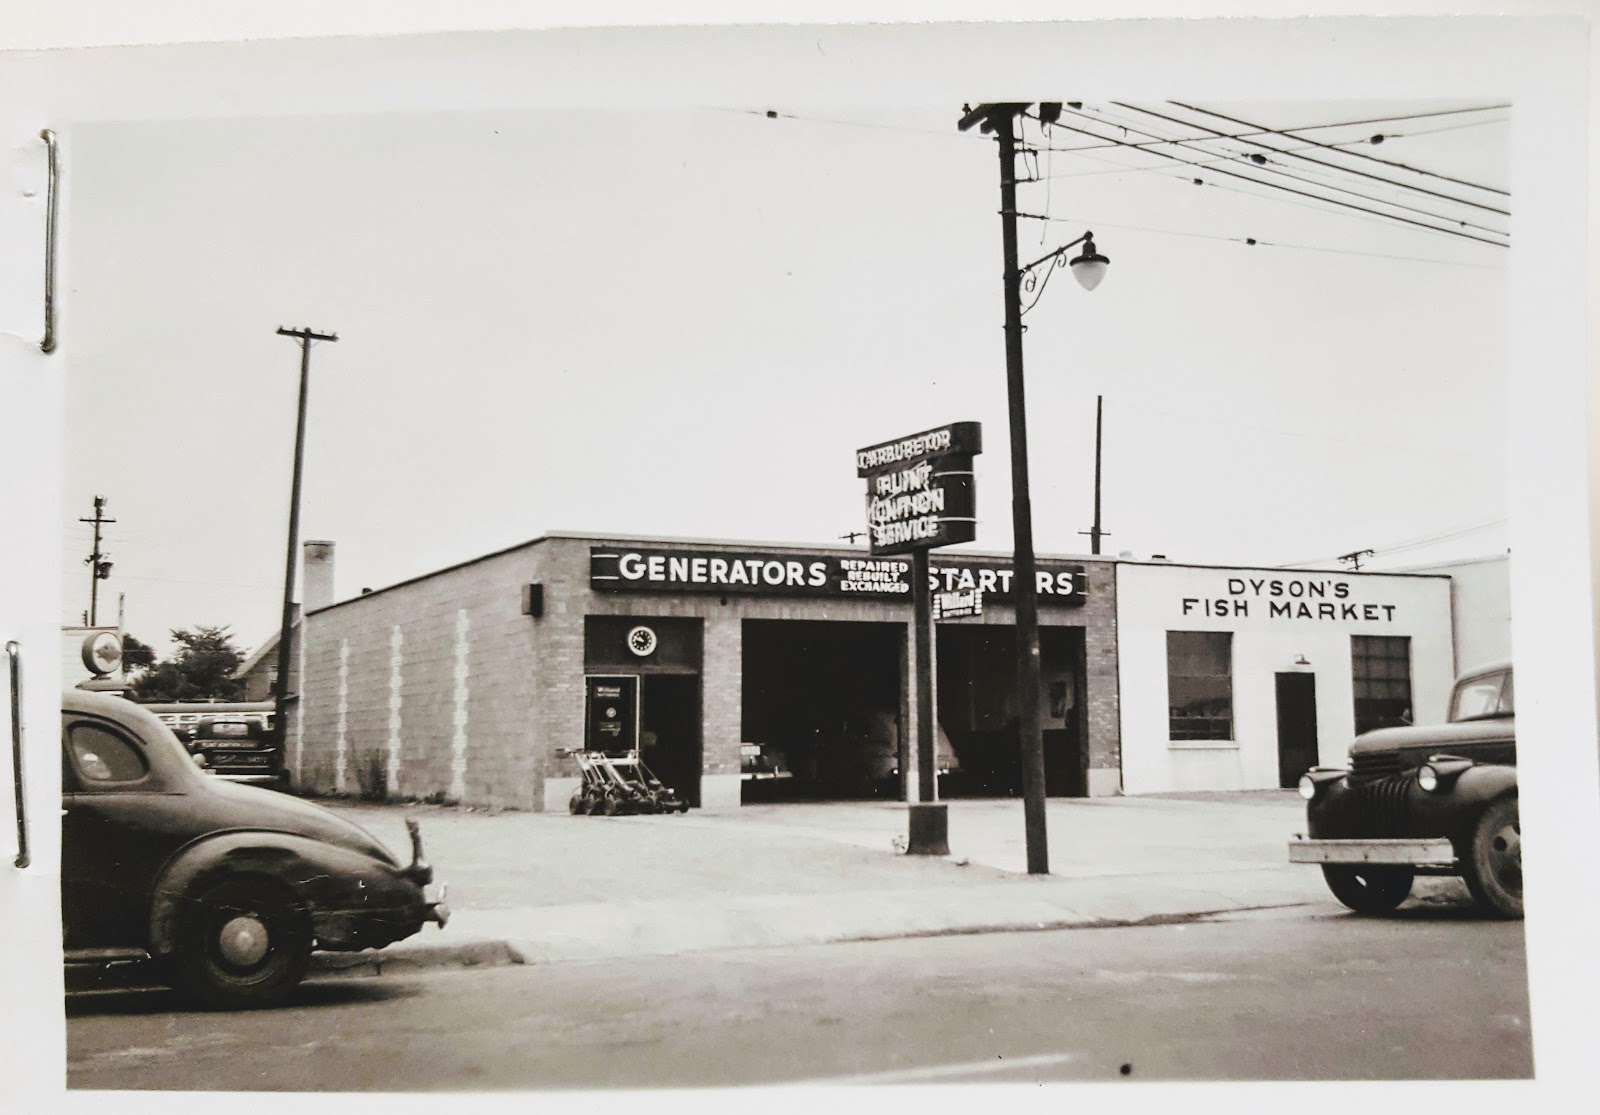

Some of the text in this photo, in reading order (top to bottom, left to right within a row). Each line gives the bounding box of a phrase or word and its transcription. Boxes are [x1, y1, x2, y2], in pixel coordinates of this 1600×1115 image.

[857, 429, 951, 469] CARBURETOR
[872, 514, 939, 547] SERVICE
[619, 553, 828, 587] GENERATORS
[840, 559, 909, 573] REPAIRED
[847, 570, 900, 583] REBUILT
[840, 580, 910, 594] EXCHANGED
[928, 567, 1074, 596] STARTRS
[1227, 578, 1350, 599] DYSON'S
[1182, 598, 1397, 622] FISH MARKET
